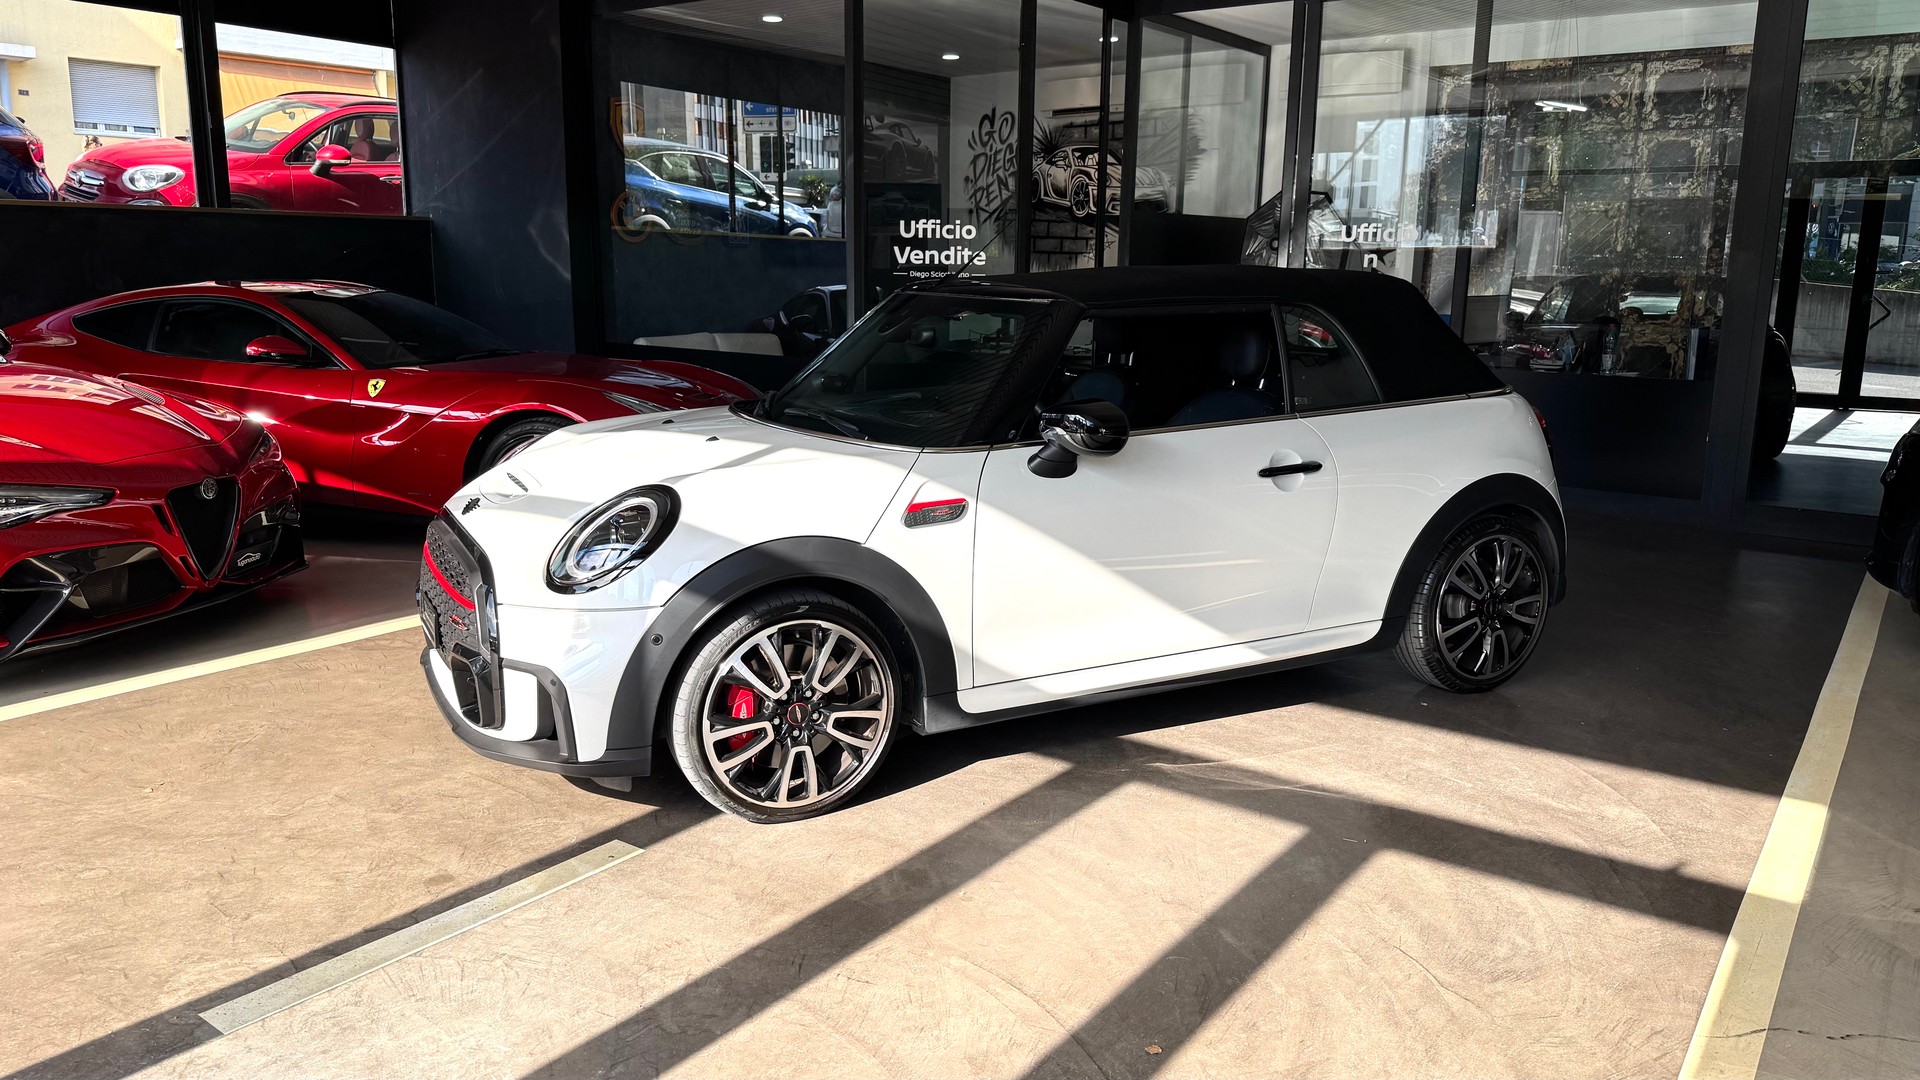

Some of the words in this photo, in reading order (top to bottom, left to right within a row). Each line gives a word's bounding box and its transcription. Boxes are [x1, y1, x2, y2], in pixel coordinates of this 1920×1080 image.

[979, 105, 1015, 148] GO
[968, 142, 1018, 188] DIEG
[900, 219, 977, 239] Ufficio
[1341, 222, 1419, 243] Ufficio
[893, 246, 987, 265] Vendite
[1363, 253, 1378, 268] n
[909, 271, 930, 279] Diego
